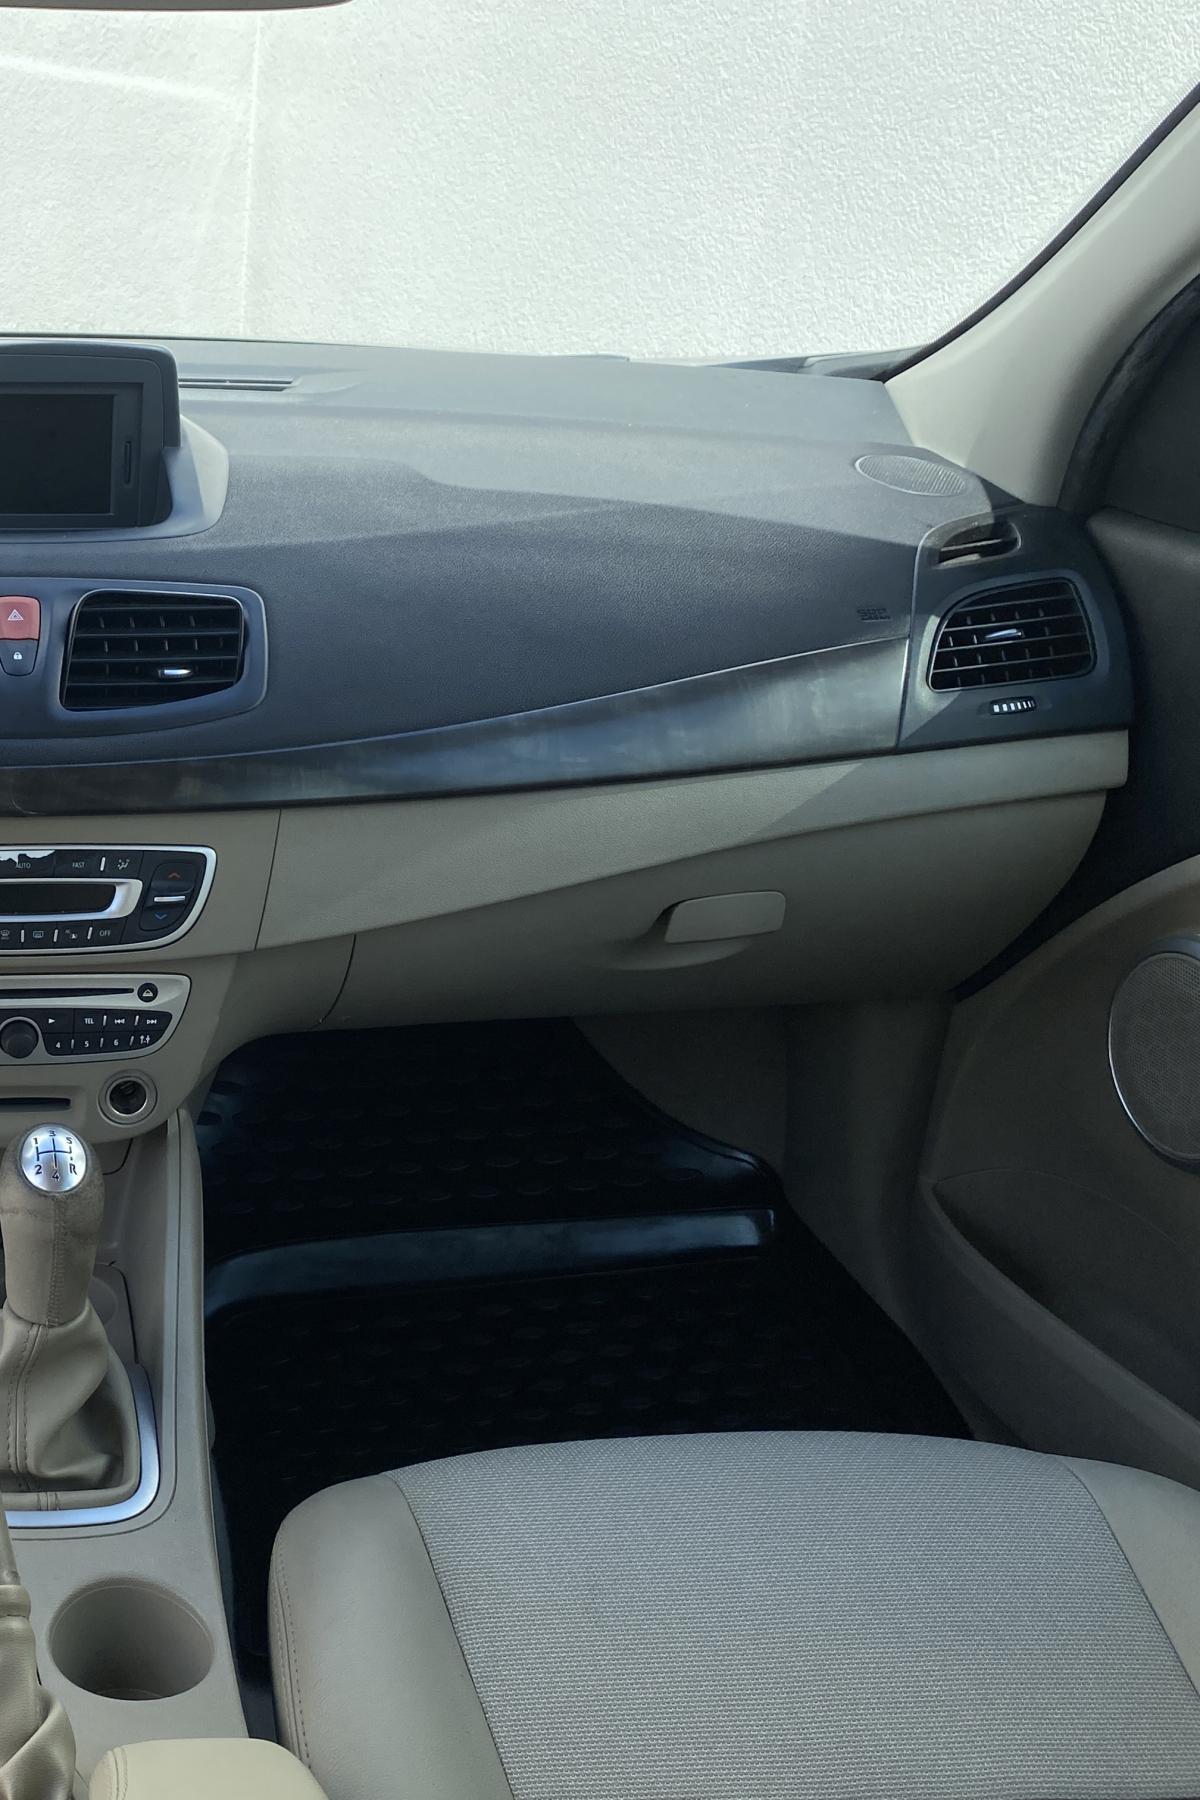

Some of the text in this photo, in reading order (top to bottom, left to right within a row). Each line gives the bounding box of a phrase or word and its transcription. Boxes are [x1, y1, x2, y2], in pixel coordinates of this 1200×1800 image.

[15, 862, 31, 870] AUTO
[34, 1164, 42, 1175] 2
[69, 1163, 78, 1175] R
[52, 1171, 60, 1180] 4
